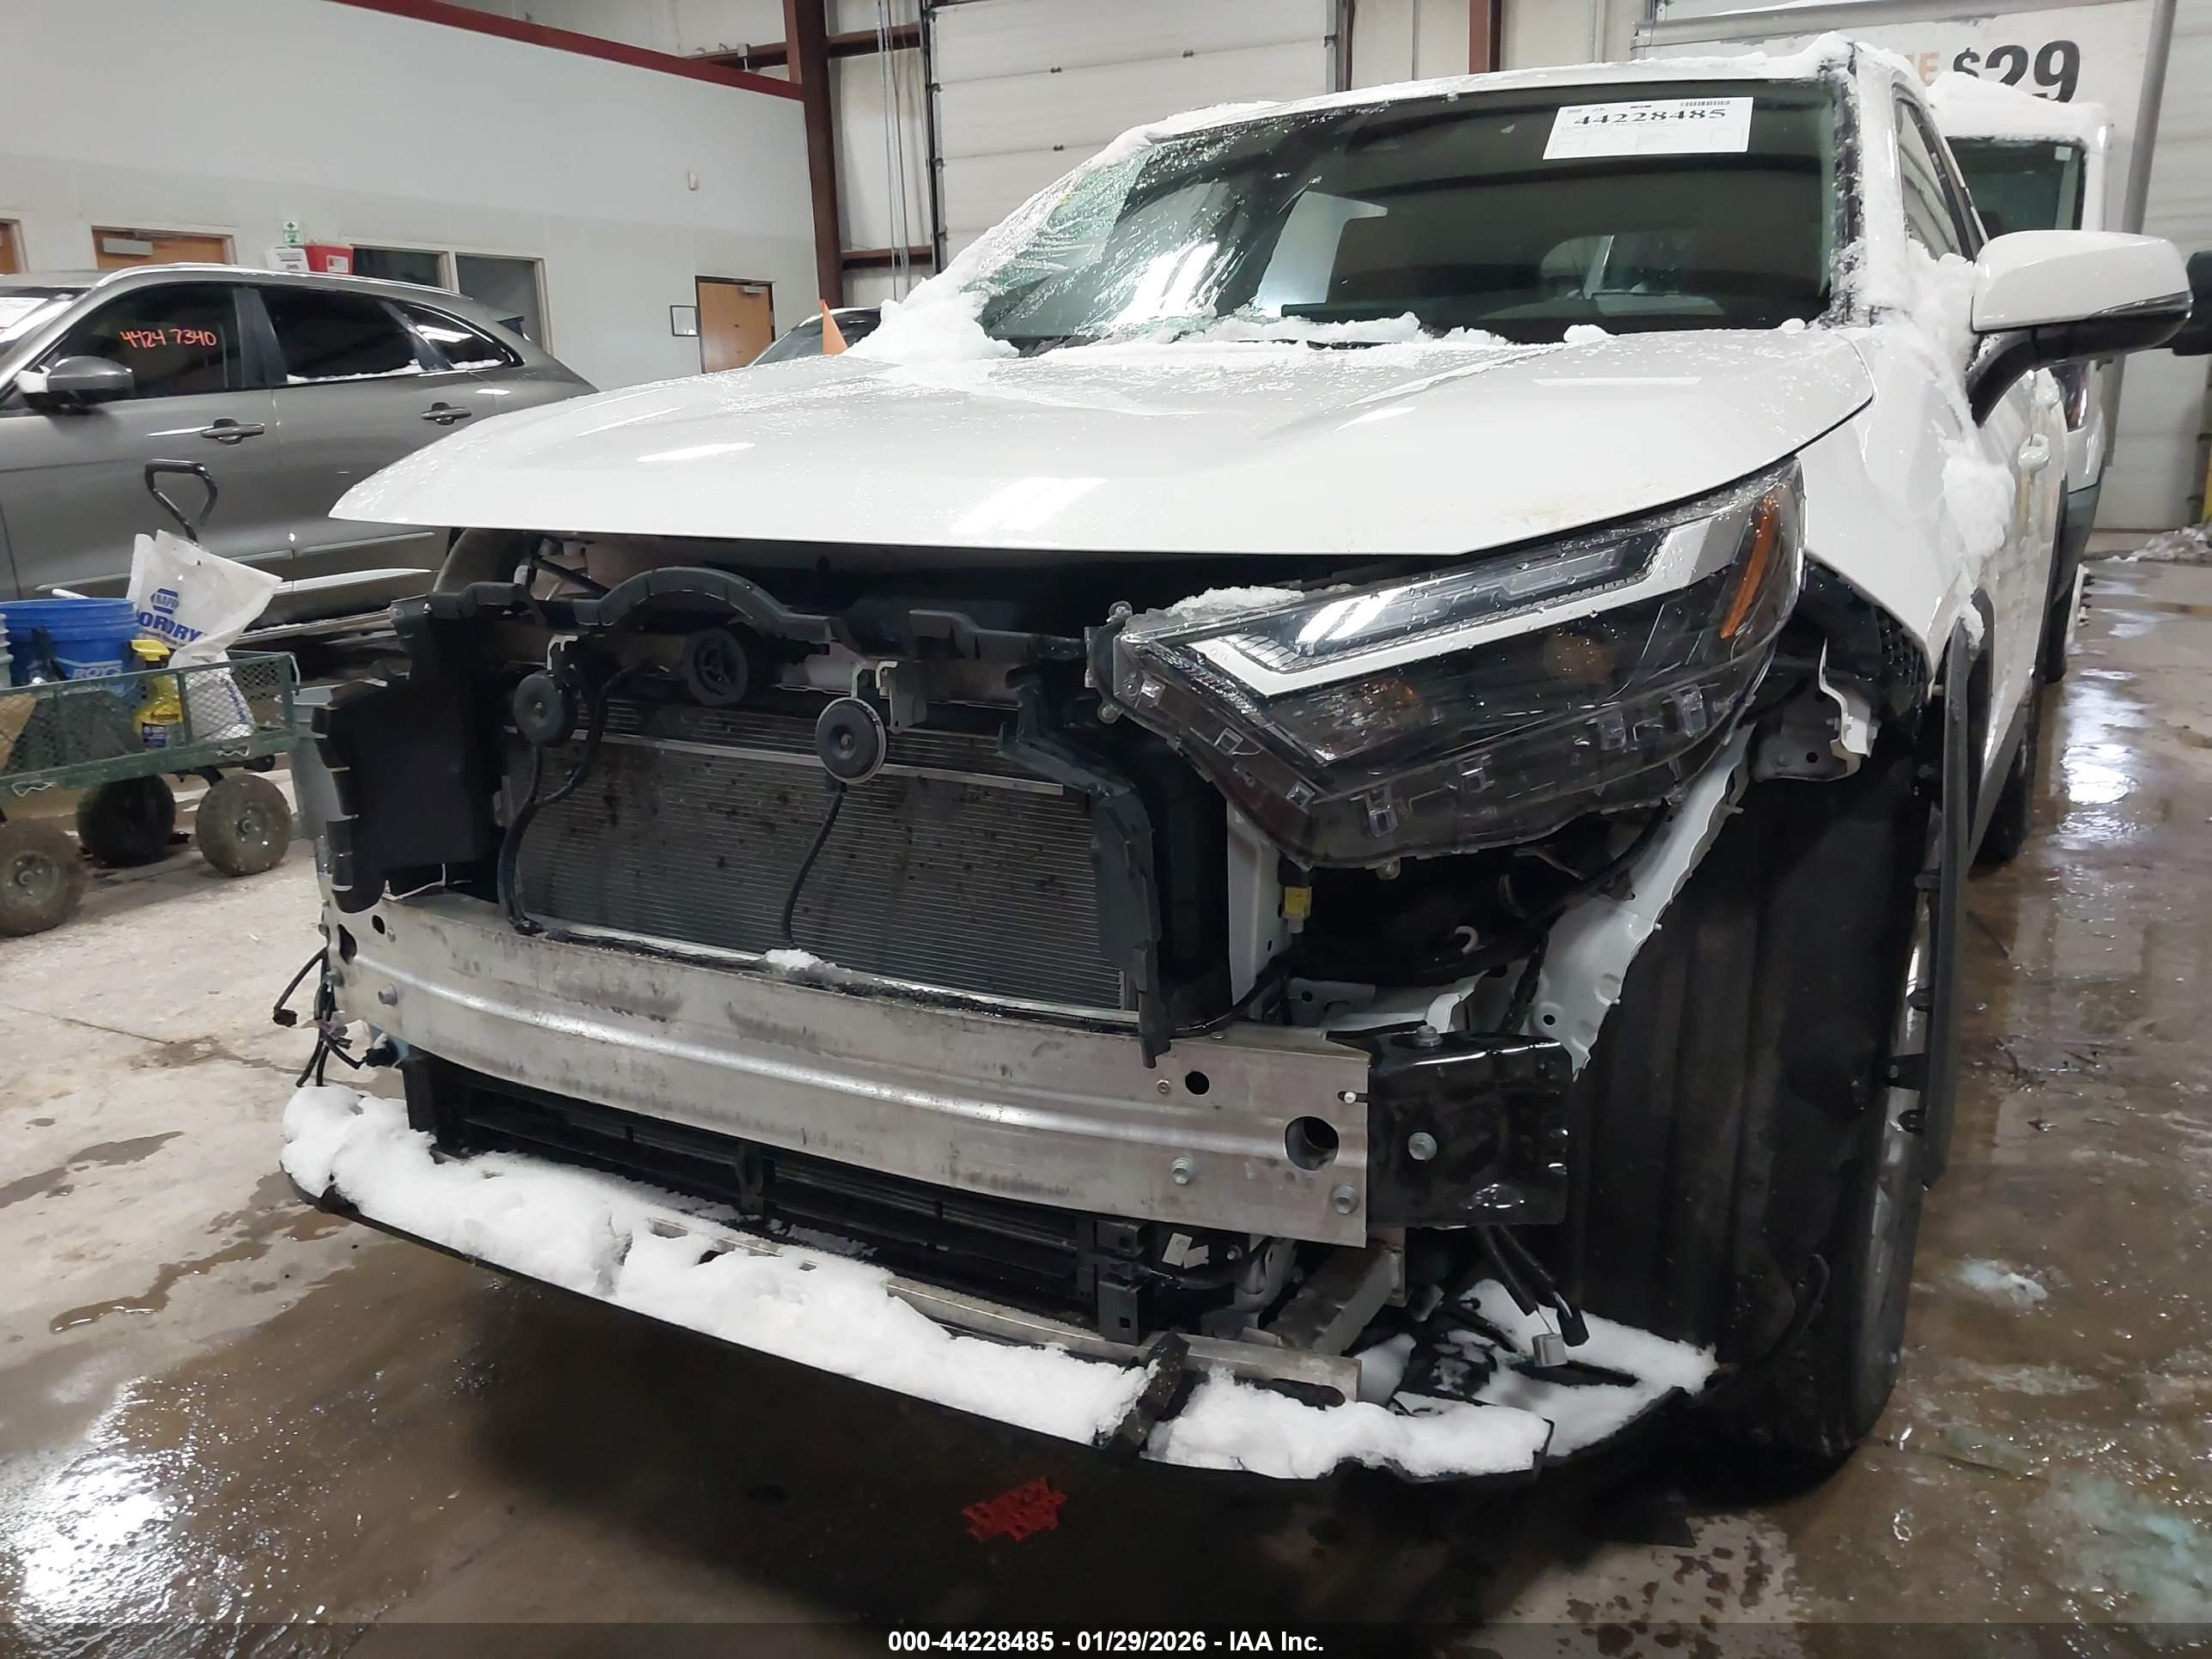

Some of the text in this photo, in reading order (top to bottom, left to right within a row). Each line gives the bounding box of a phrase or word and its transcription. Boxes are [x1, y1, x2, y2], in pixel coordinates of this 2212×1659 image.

[1953, 40, 2081, 104] $29
[1574, 108, 1726, 125] 44228485
[119, 328, 218, 349] 4424 7340
